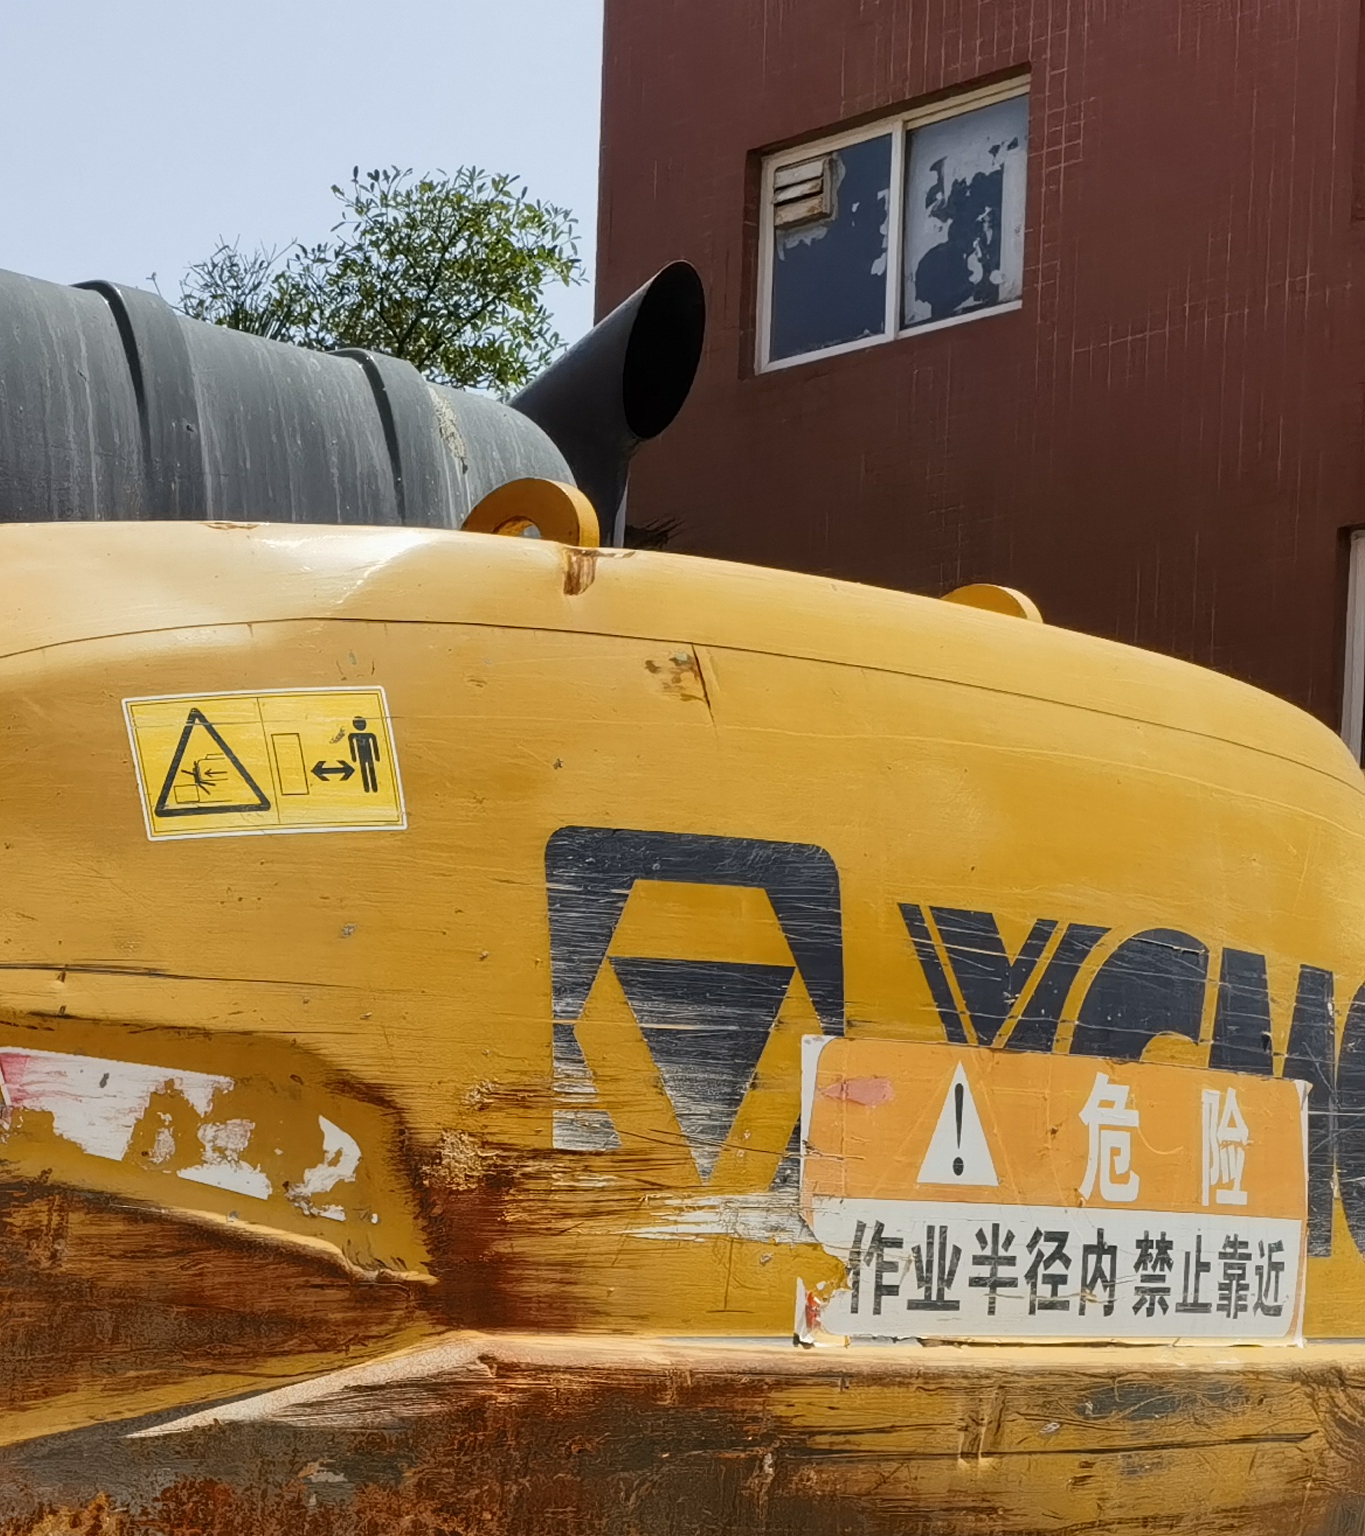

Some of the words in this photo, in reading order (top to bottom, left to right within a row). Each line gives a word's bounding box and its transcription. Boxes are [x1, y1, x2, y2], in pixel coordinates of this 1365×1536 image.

[1079, 1072, 1250, 1207] 危险
[849, 1219, 1286, 1318] 作业半径内禁止靠近
